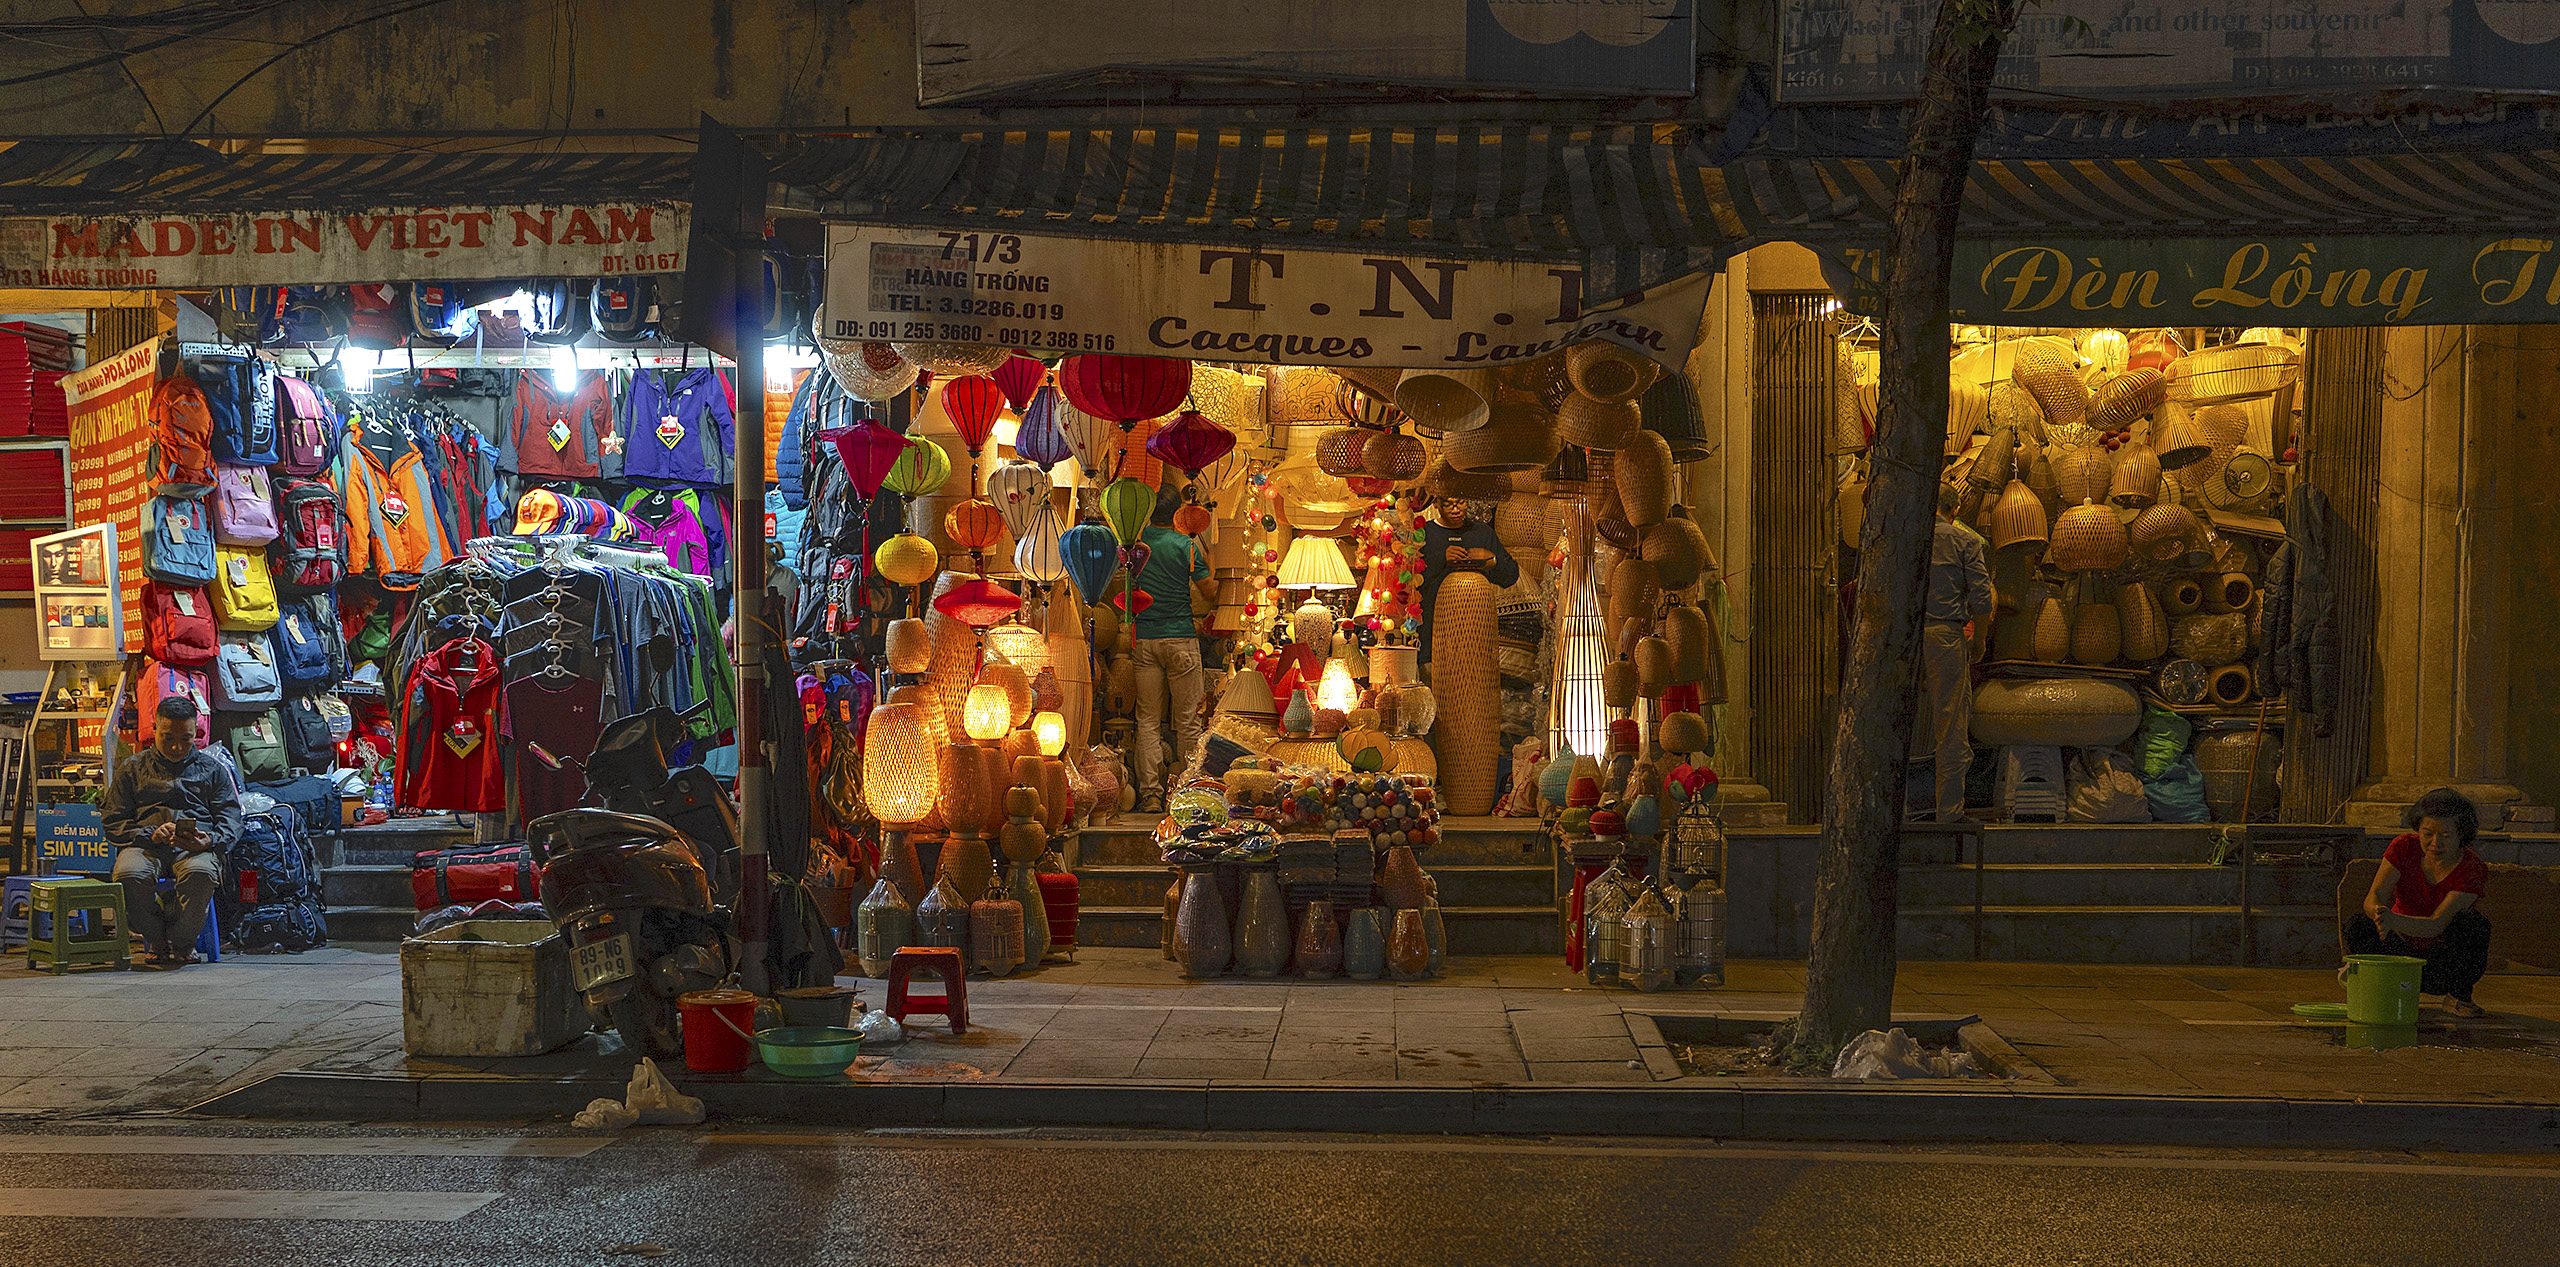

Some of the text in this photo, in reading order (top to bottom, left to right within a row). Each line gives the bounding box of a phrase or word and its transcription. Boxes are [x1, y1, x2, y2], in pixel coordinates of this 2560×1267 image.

[1813, 11, 1934, 37] Wholes
[2109, 8, 2160, 32] and
[2173, 8, 2249, 32] other
[2261, 13, 2382, 31] souvenir
[1787, 69, 1825, 87] Kiốt
[1833, 71, 1844, 86] 6
[1867, 71, 1905, 86] 71A
[2384, 64, 2434, 78] 6415
[52, 207, 655, 258] MADE IN VIỆT NAM
[635, 252, 680, 271] 0167
[938, 231, 1021, 264] 71/3
[38, 265, 88, 285] HÀNG
[96, 265, 157, 285] TRỐNG
[905, 265, 1050, 293] HÀNG TRỐNG
[1980, 245, 2168, 313] Đèn
[2191, 242, 2433, 323] Lồng
[888, 293, 931, 311] TEL:
[940, 297, 1064, 320] 3.9286.019
[836, 319, 863, 337] DĐ:
[869, 321, 896, 338] 091
[904, 322, 935, 340] 255
[940, 324, 982, 342] 3680
[1000, 327, 1041, 346] 0912
[1046, 330, 1078, 348] 388
[1084, 333, 1115, 351] 516
[1148, 316, 1373, 362] Cacques
[1444, 318, 1666, 362] Lantern
[97, 405, 113, 444] SIM
[53, 824, 98, 837] ĐIỂM BÁN
[43, 837, 109, 858] SIM THẺ
[579, 938, 623, 966] 89-N6
